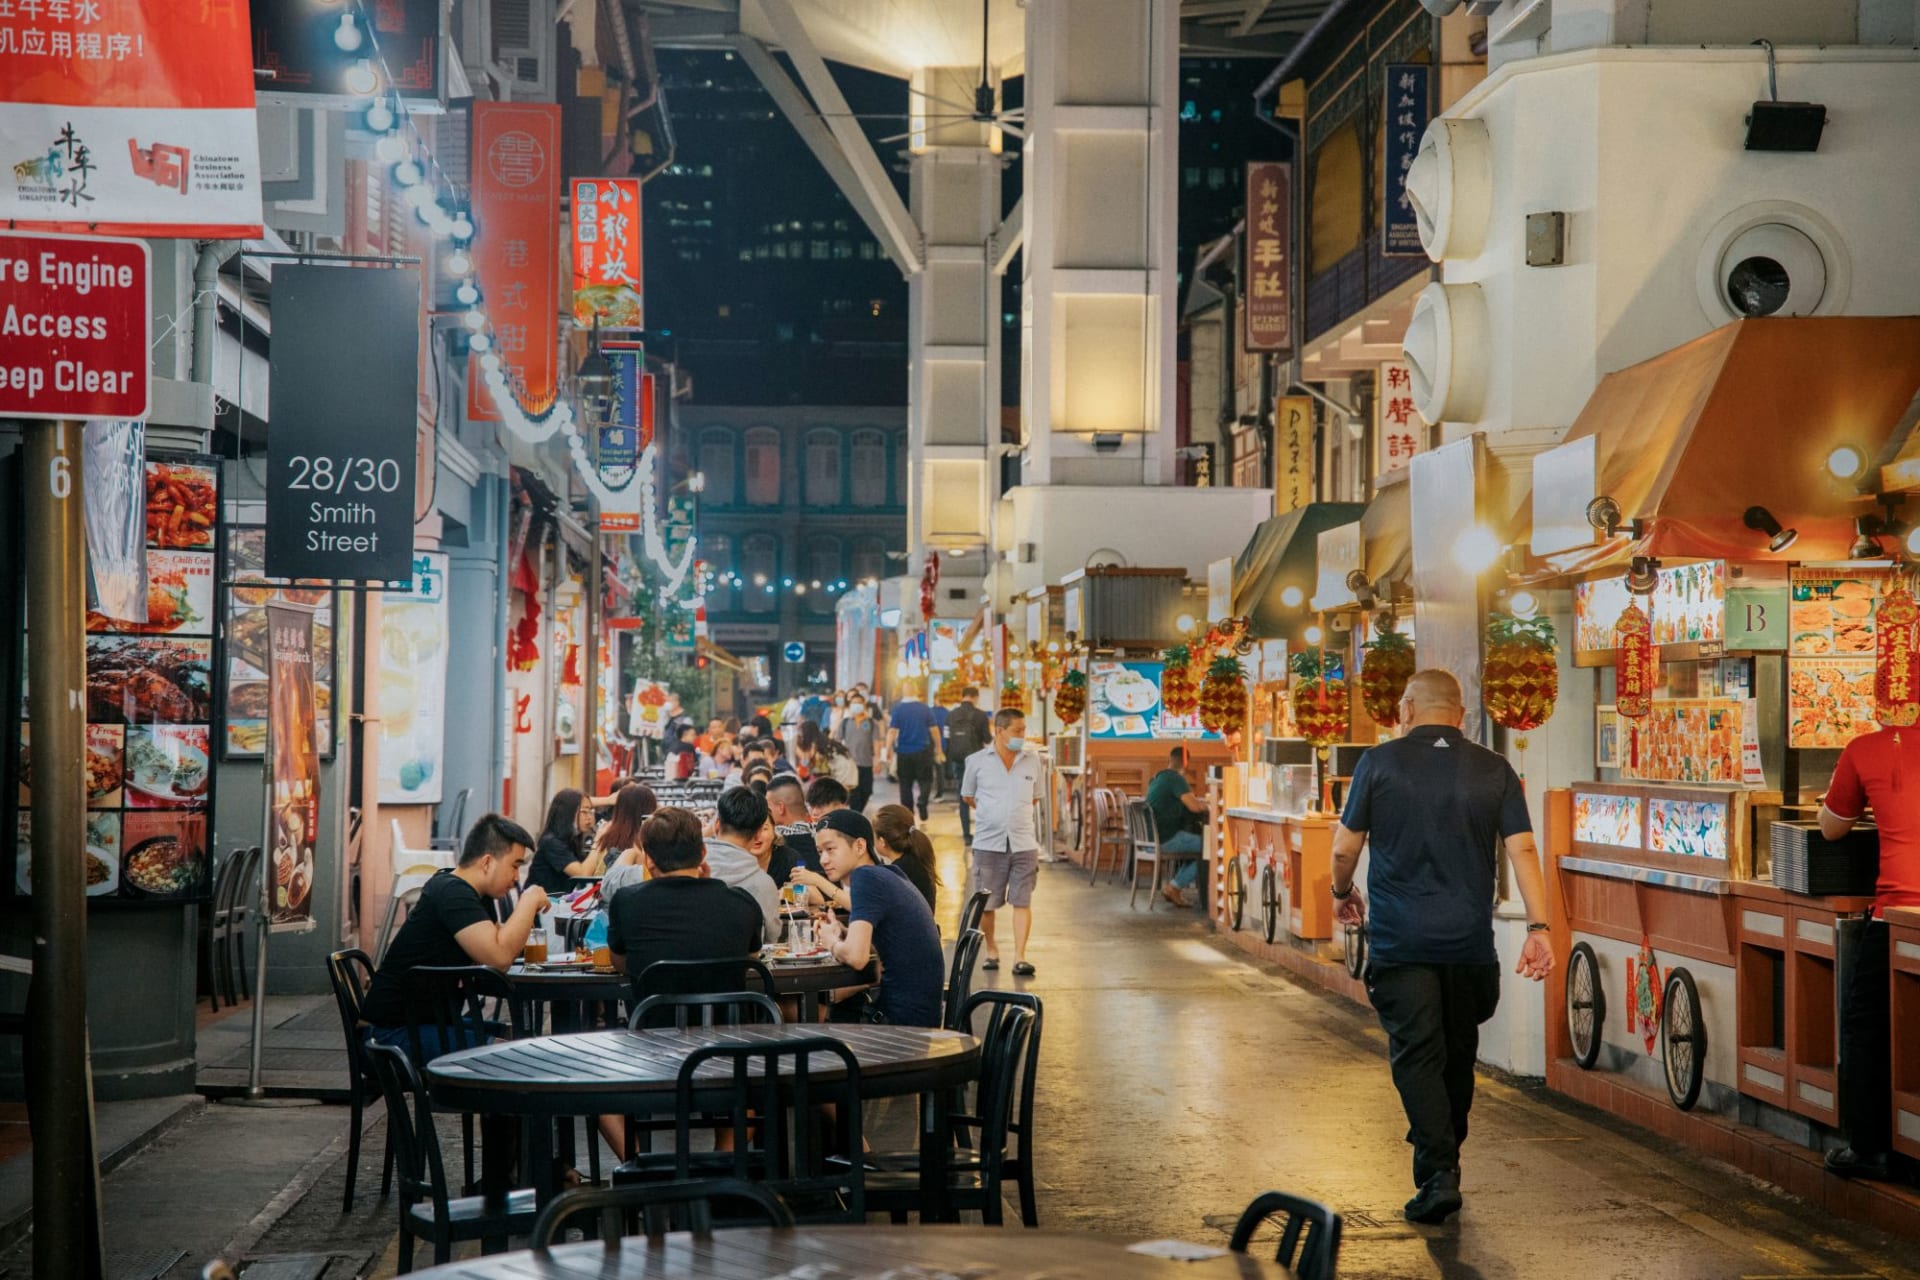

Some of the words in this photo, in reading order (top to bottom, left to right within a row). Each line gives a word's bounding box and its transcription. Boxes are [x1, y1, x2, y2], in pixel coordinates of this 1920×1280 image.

[40, 252, 133, 295] Engine
[2, 304, 107, 340] Access
[55, 360, 134, 394] Clear
[1385, 366, 1417, 473] 新聲詩
[288, 455, 400, 495] 28/30
[309, 501, 376, 524] Smith
[306, 530, 379, 552] Street
